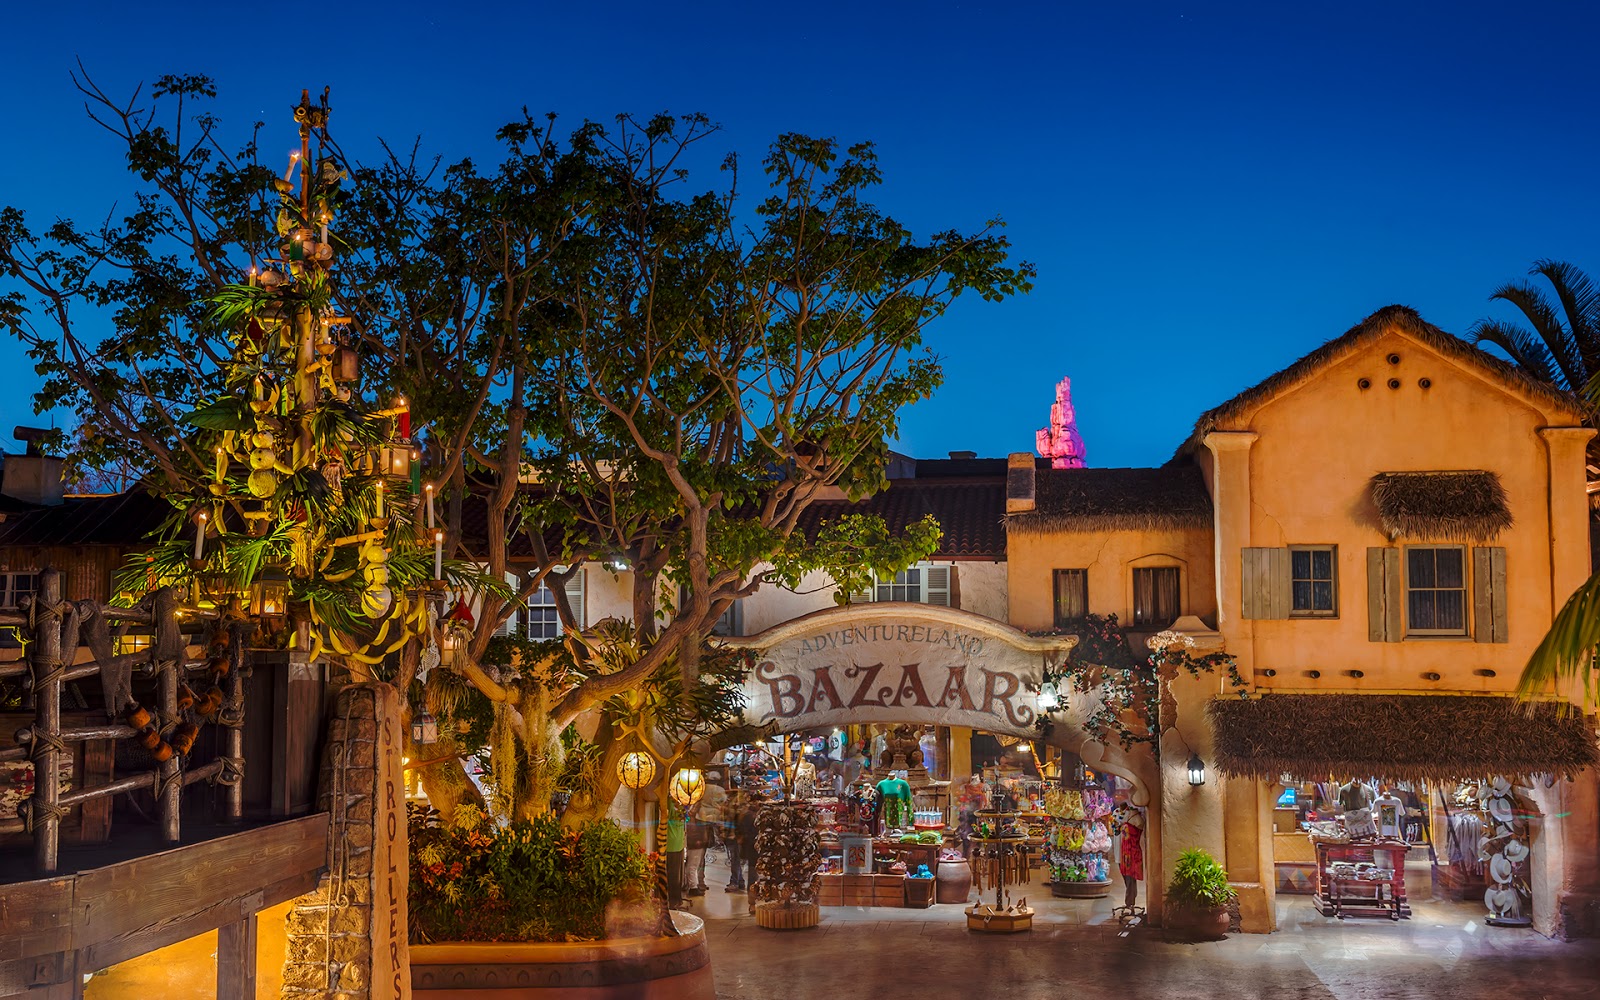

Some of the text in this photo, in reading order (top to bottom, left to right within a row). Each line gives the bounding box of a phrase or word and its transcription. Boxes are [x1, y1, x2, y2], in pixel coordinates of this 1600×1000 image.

[800, 624, 984, 657] ADVENTURELAND
[755, 662, 1034, 728] BAZAAR
[384, 717, 402, 1000] STROLLERS
